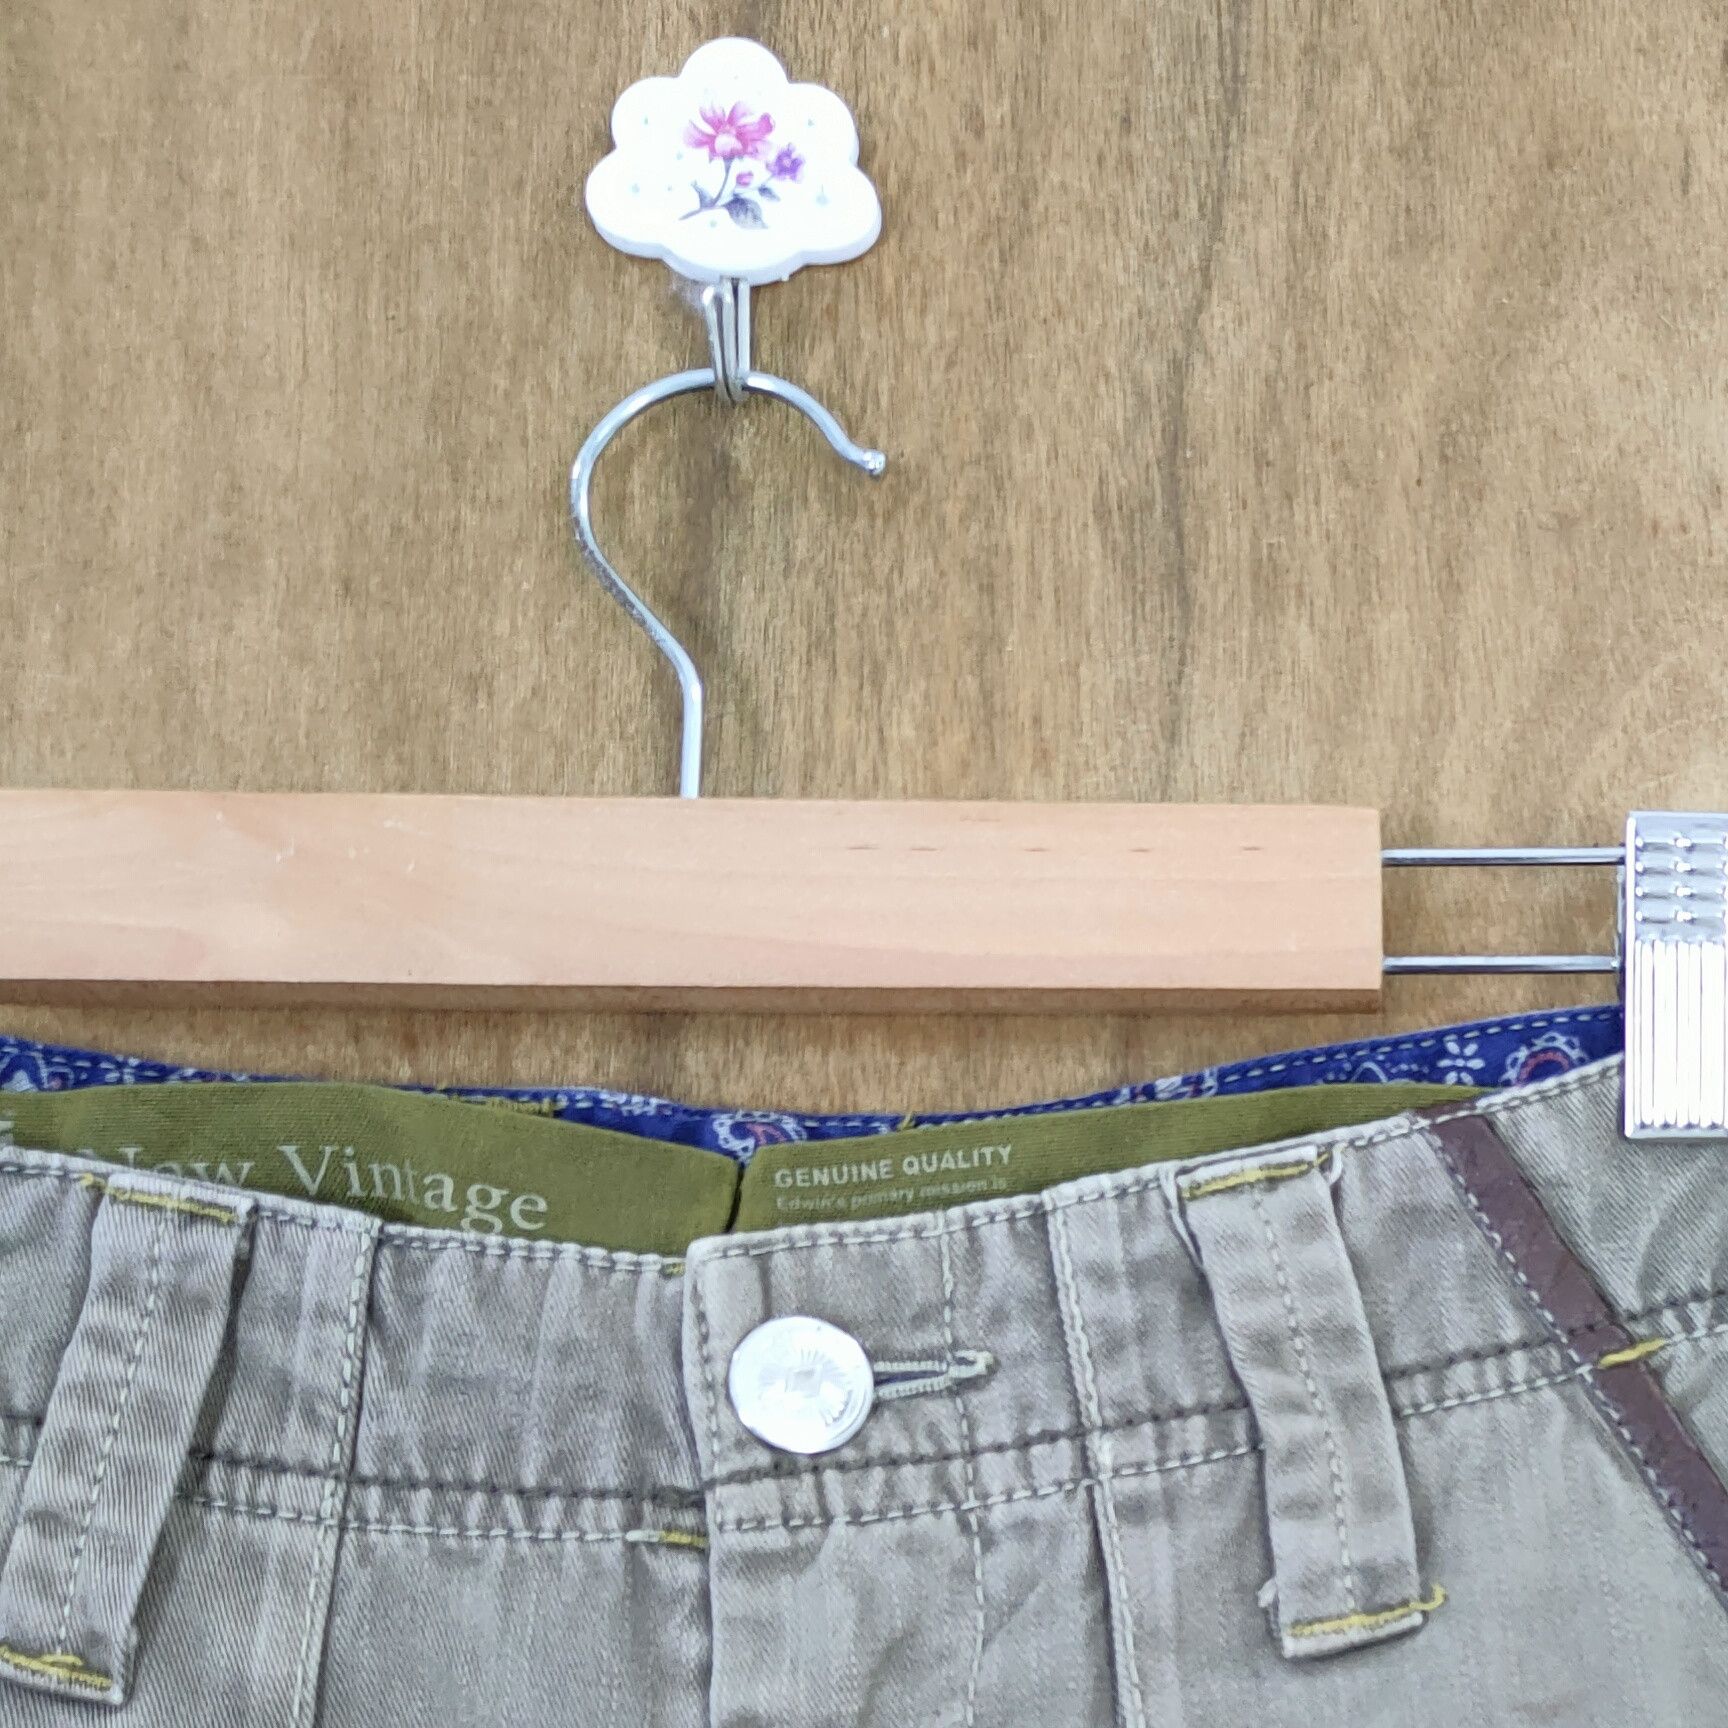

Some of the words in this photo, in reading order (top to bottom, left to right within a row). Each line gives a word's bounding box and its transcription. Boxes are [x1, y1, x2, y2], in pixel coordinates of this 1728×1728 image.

[277, 1145, 548, 1233] Vintage
[774, 1158, 895, 1190] GENUINE
[902, 1144, 1012, 1177] QUALITY
